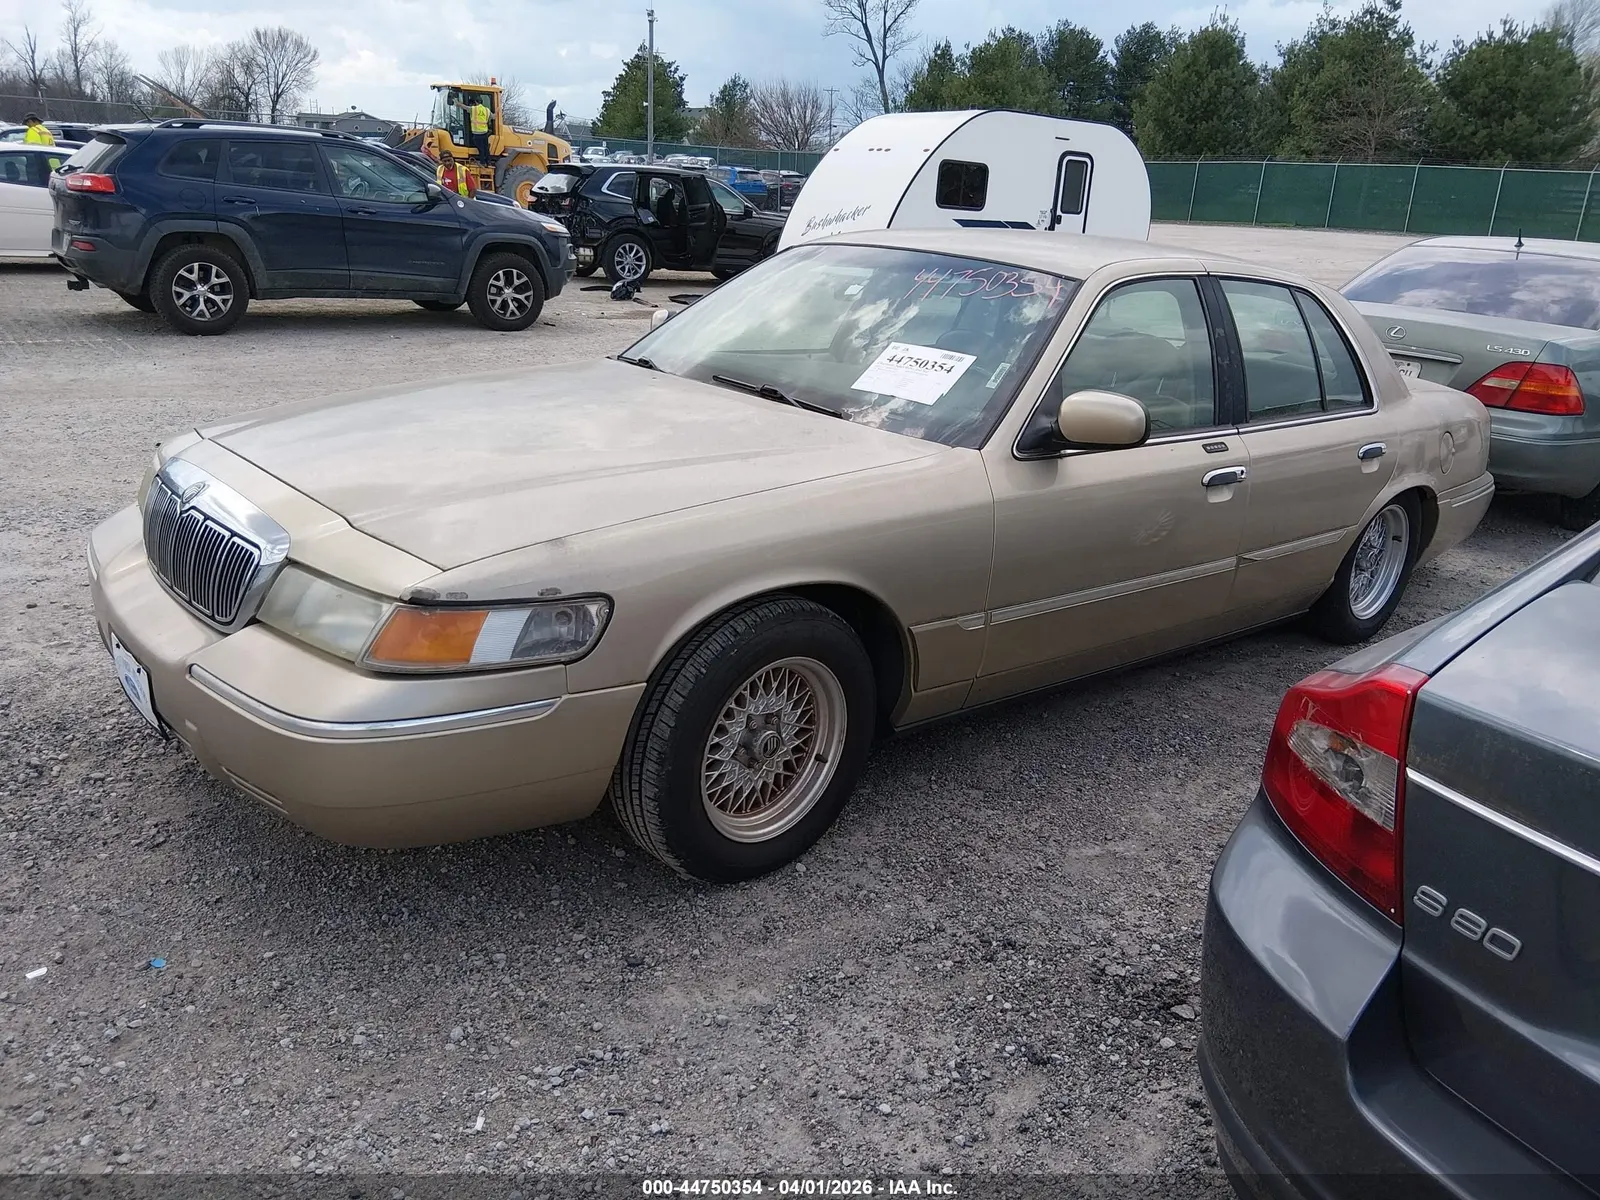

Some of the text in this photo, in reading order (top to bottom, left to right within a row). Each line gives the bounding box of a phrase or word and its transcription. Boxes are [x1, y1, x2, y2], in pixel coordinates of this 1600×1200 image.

[801, 204, 872, 236] Bushwhacker
[903, 267, 1063, 309] 44750354
[1486, 344, 1531, 356] LS 430
[887, 354, 955, 374] 44750354
